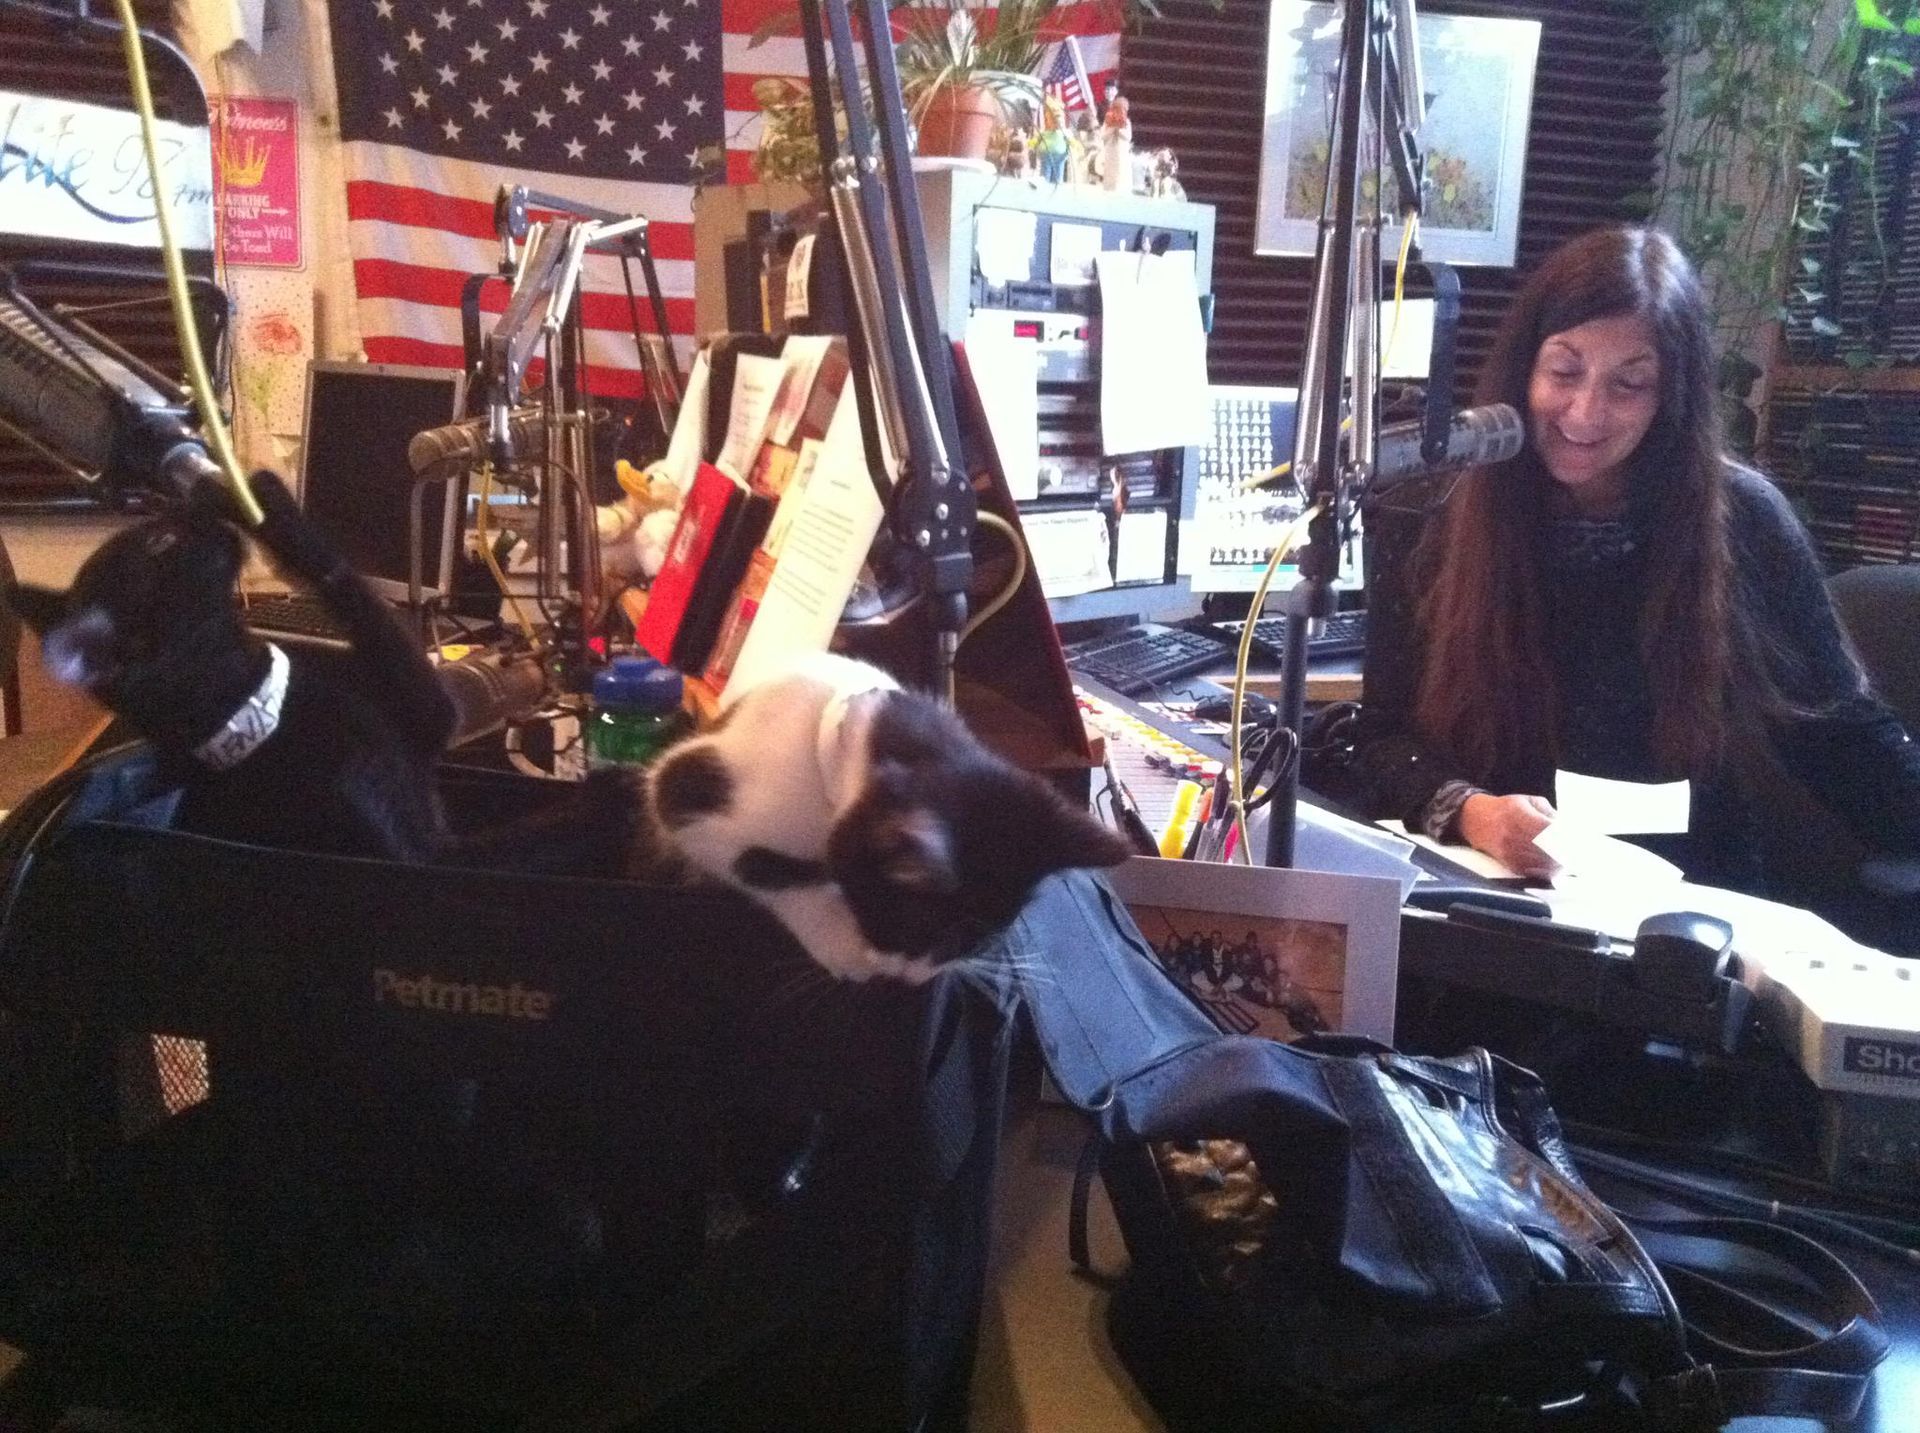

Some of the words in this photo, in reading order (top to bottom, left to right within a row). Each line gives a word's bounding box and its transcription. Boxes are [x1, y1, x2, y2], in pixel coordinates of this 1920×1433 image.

[227, 207, 260, 219] ONLY
[263, 223, 293, 240] Will
[373, 968, 550, 1020] Petmate
